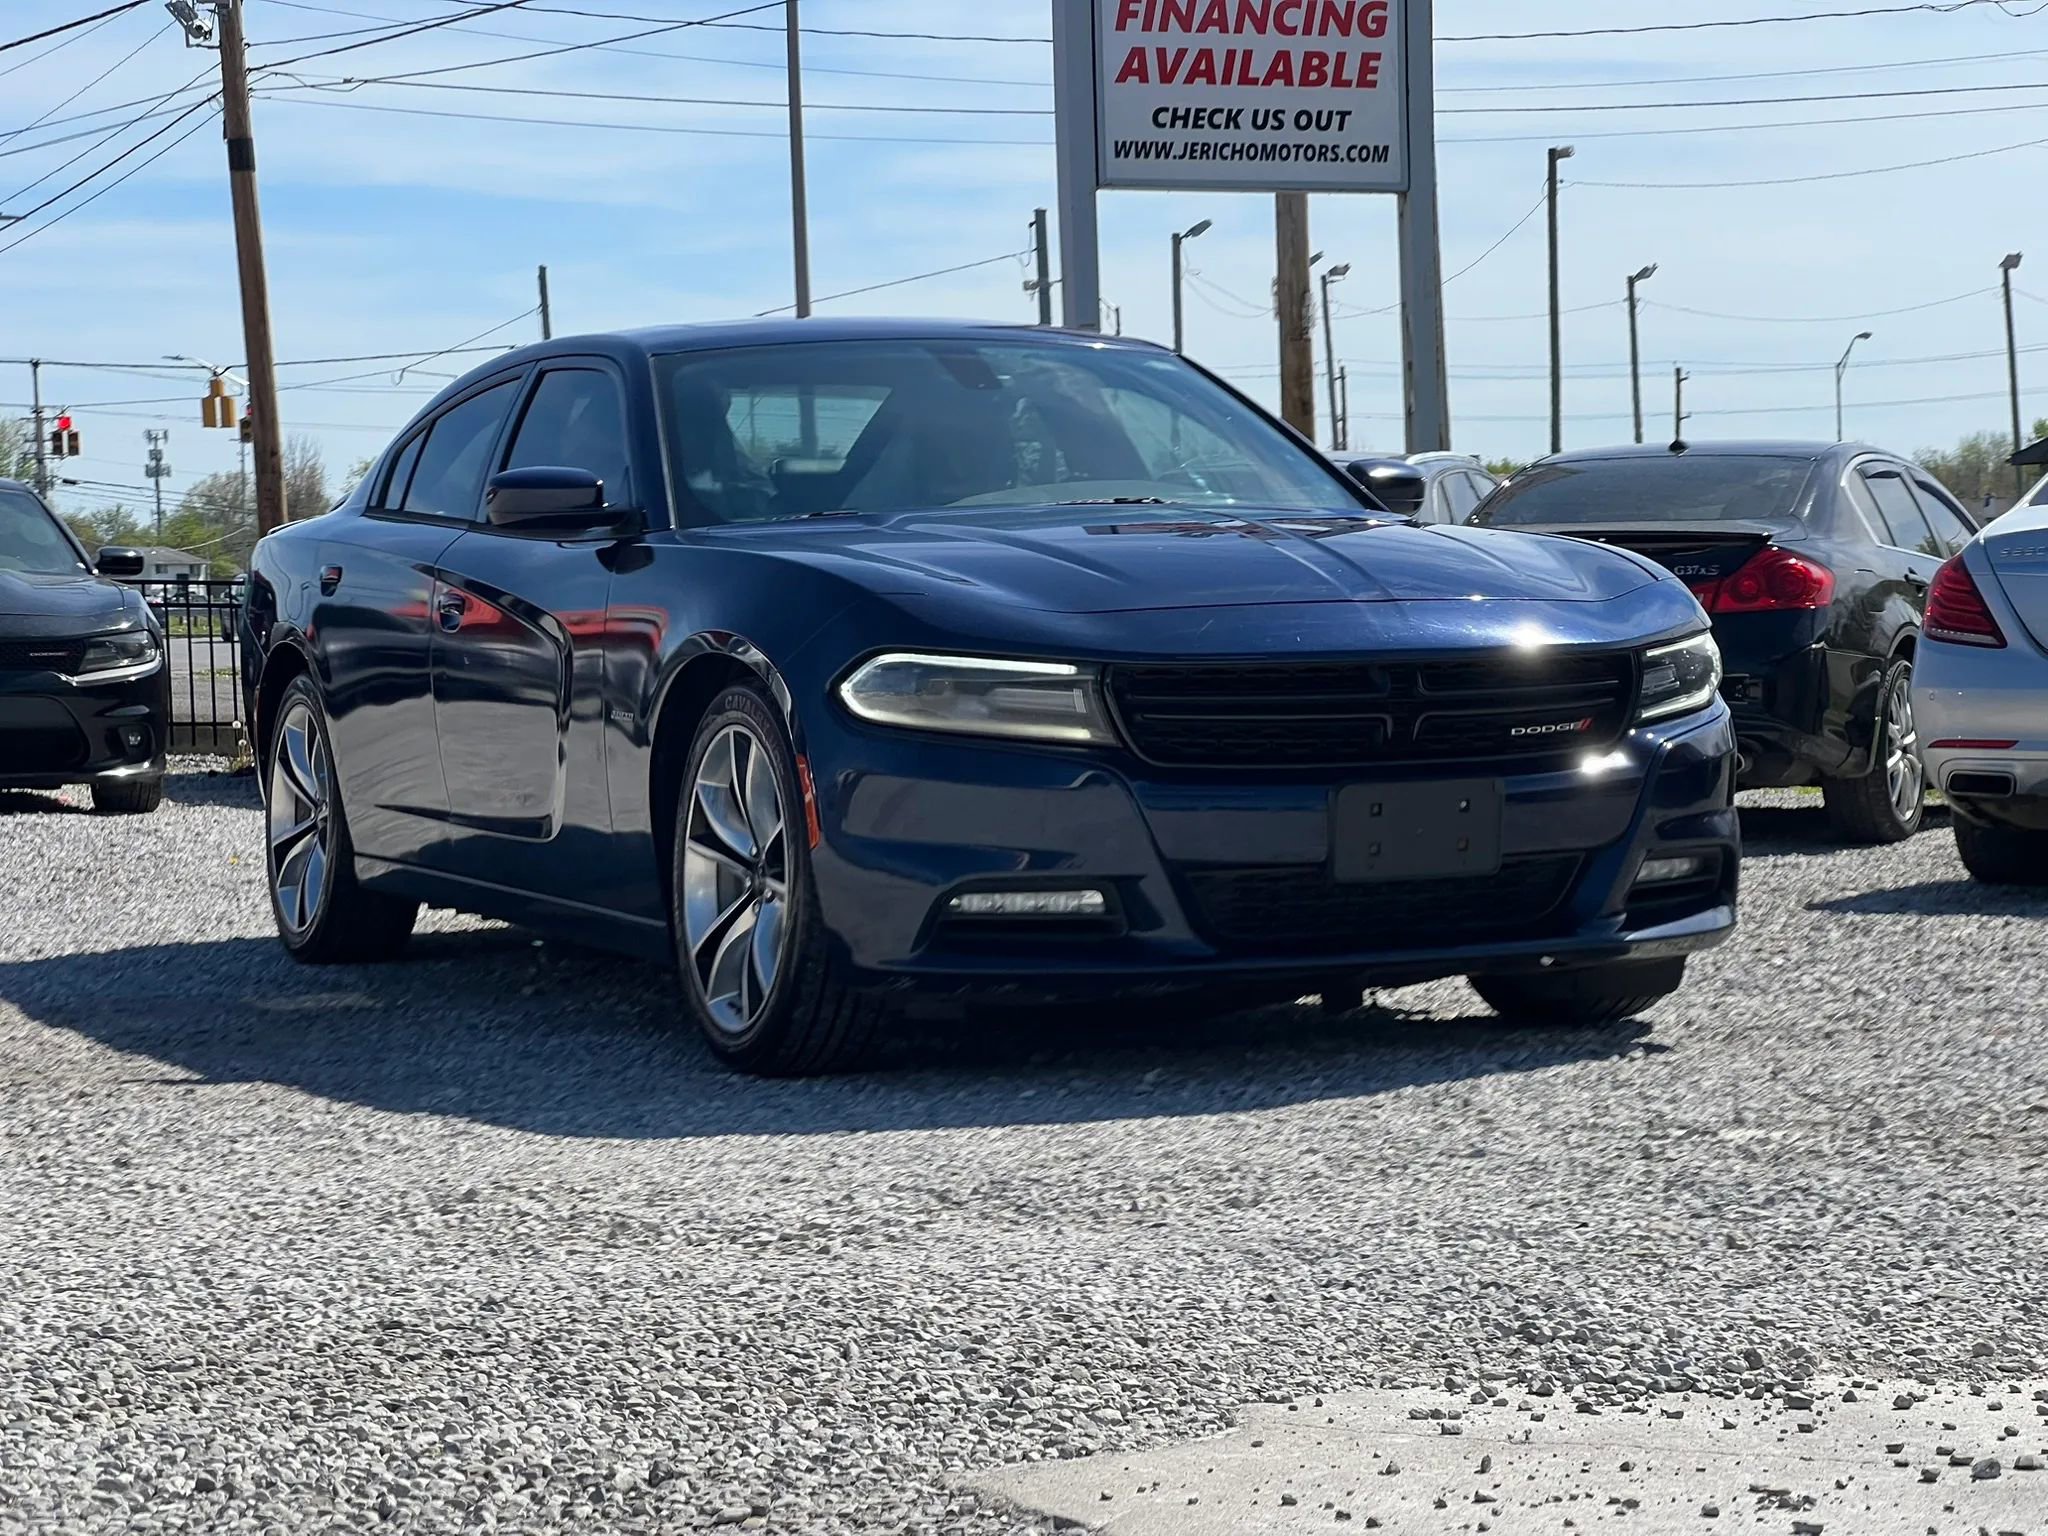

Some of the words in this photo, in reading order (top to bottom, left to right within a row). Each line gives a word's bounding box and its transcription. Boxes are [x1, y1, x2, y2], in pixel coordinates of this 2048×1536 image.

[1115, 0, 1389, 38] FINANCING
[1114, 47, 1382, 89] AVAILABLE
[1152, 106, 1245, 131] CHECK
[1251, 108, 1286, 132] US
[1294, 109, 1353, 132] OUT
[1113, 140, 1390, 164] WWW.JERICHOMOTORS.COM
[1511, 721, 1582, 736] DODGE
